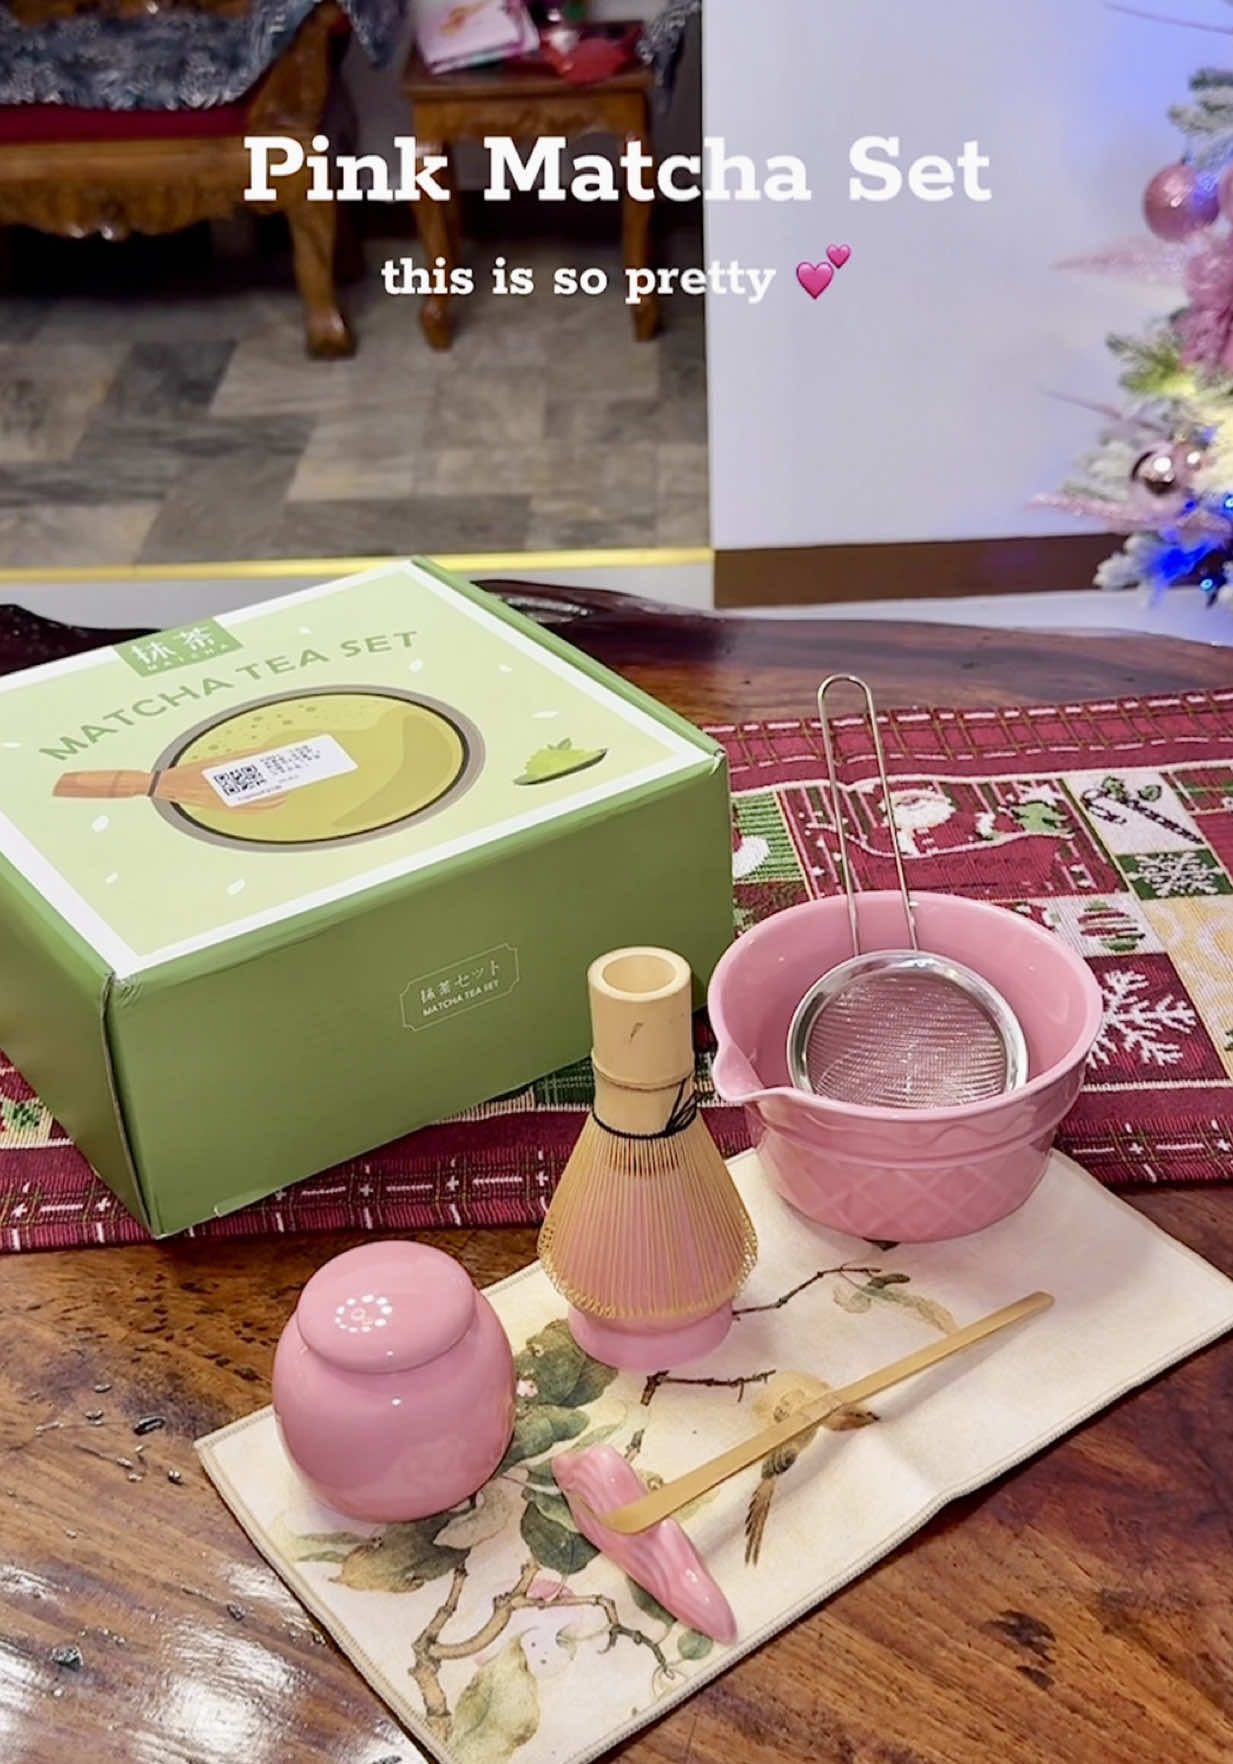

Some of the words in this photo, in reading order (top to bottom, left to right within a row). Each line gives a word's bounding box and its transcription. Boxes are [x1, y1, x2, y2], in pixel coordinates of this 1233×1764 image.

[131, 627, 215, 664] 抹茶
[39, 672, 235, 761] MATCHA
[235, 648, 329, 682] TEA
[340, 630, 418, 658] SET
